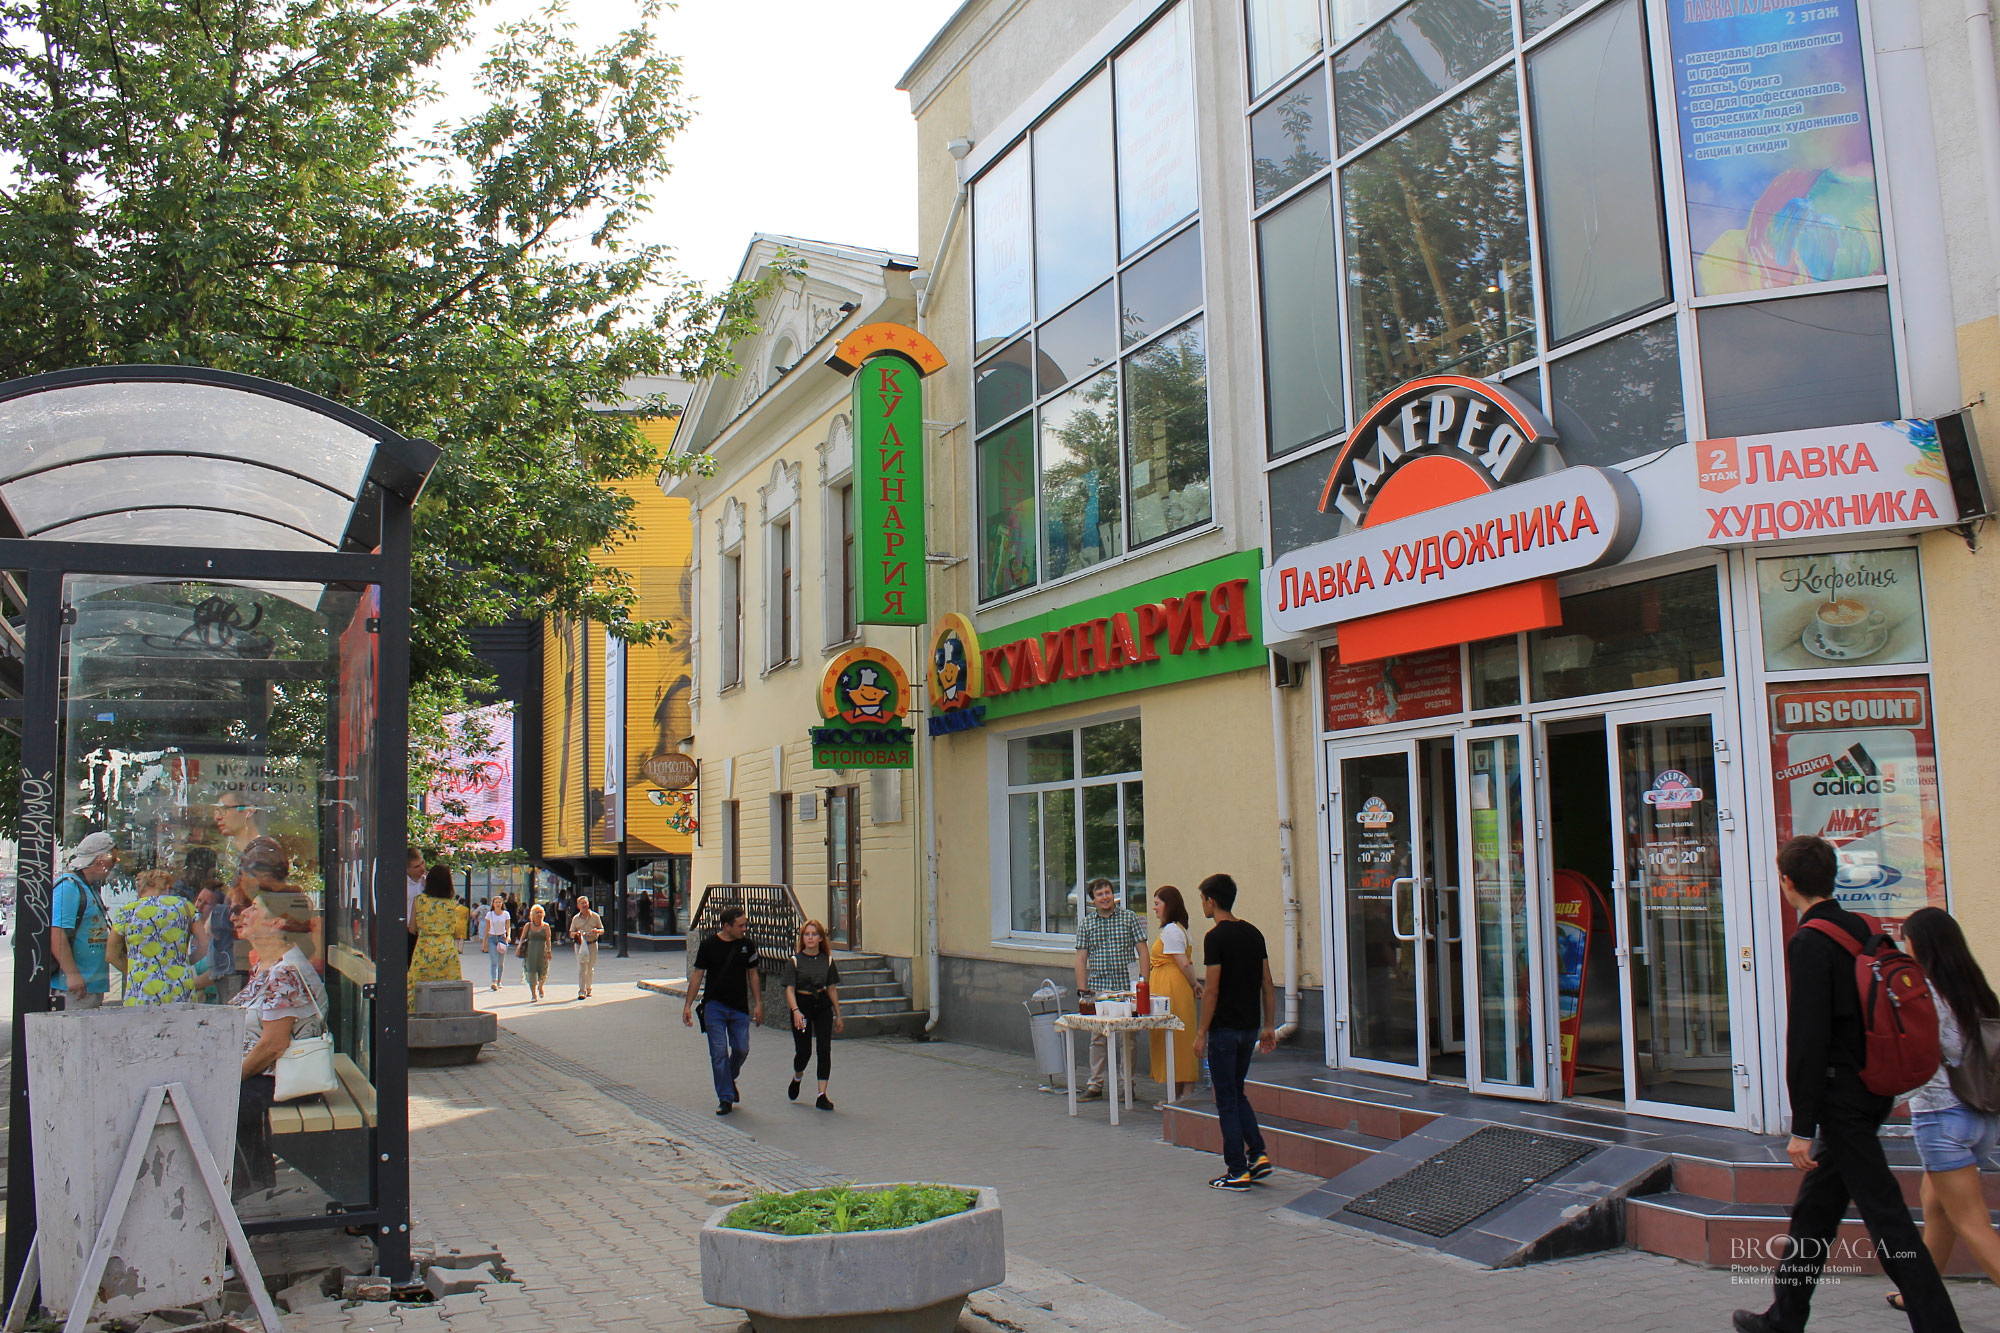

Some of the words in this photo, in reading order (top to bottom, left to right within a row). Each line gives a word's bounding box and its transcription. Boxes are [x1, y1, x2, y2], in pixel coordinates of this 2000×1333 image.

[1786, 12, 1796, 24] 2
[1801, 5, 1840, 23] этаж
[1687, 49, 1751, 63] материалы
[1756, 44, 1777, 56] для
[1782, 33, 1842, 50] живописи
[1688, 70, 1697, 80] и
[1700, 64, 1749, 79] графики
[1690, 82, 1736, 95] холсты,
[1740, 76, 1780, 90] бумага
[1692, 101, 1712, 112] все
[1716, 98, 1737, 110] для
[1742, 83, 1845, 105] профессионалов,
[1693, 112, 1760, 128] творческих
[1763, 104, 1803, 119] людей
[1694, 133, 1703, 143] и
[1706, 124, 1781, 142] начинающих
[1785, 113, 1859, 131] художников
[1696, 148, 1731, 160] акции
[1735, 144, 1743, 154] и
[1747, 140, 1788, 153] скидки
[1335, 395, 1525, 526] ГАЛЕРЕЯ
[1709, 449, 1728, 470] 2
[1745, 442, 1879, 486] ЛАВКА
[1701, 471, 1738, 483] ЭТАЖ
[878, 367, 907, 616] КУЛИНАРИЯ
[1705, 489, 1939, 541] ХУДОЖНИКА
[1279, 556, 1375, 612] ЛАВКА
[1383, 495, 1599, 586] ХУДОЖНИКА
[1779, 563, 1897, 604] Кофейня
[980, 578, 1253, 698] КУЛИНАРИЯ
[1330, 690, 1358, 700] ПРИРОДНАЯ
[1366, 686, 1375, 706] 3
[1424, 699, 1452, 709] СРЕДСТВА
[1331, 702, 1358, 712] КОСМЕТИКА
[1784, 699, 1917, 724] DISCOUNT
[818, 750, 909, 765] СТОЛОВАЯ
[1776, 757, 1830, 780] СКИДКИ
[1812, 777, 1896, 796] adidas
[1827, 807, 1880, 832] NIKE
[1834, 893, 1902, 902] ALOMON
